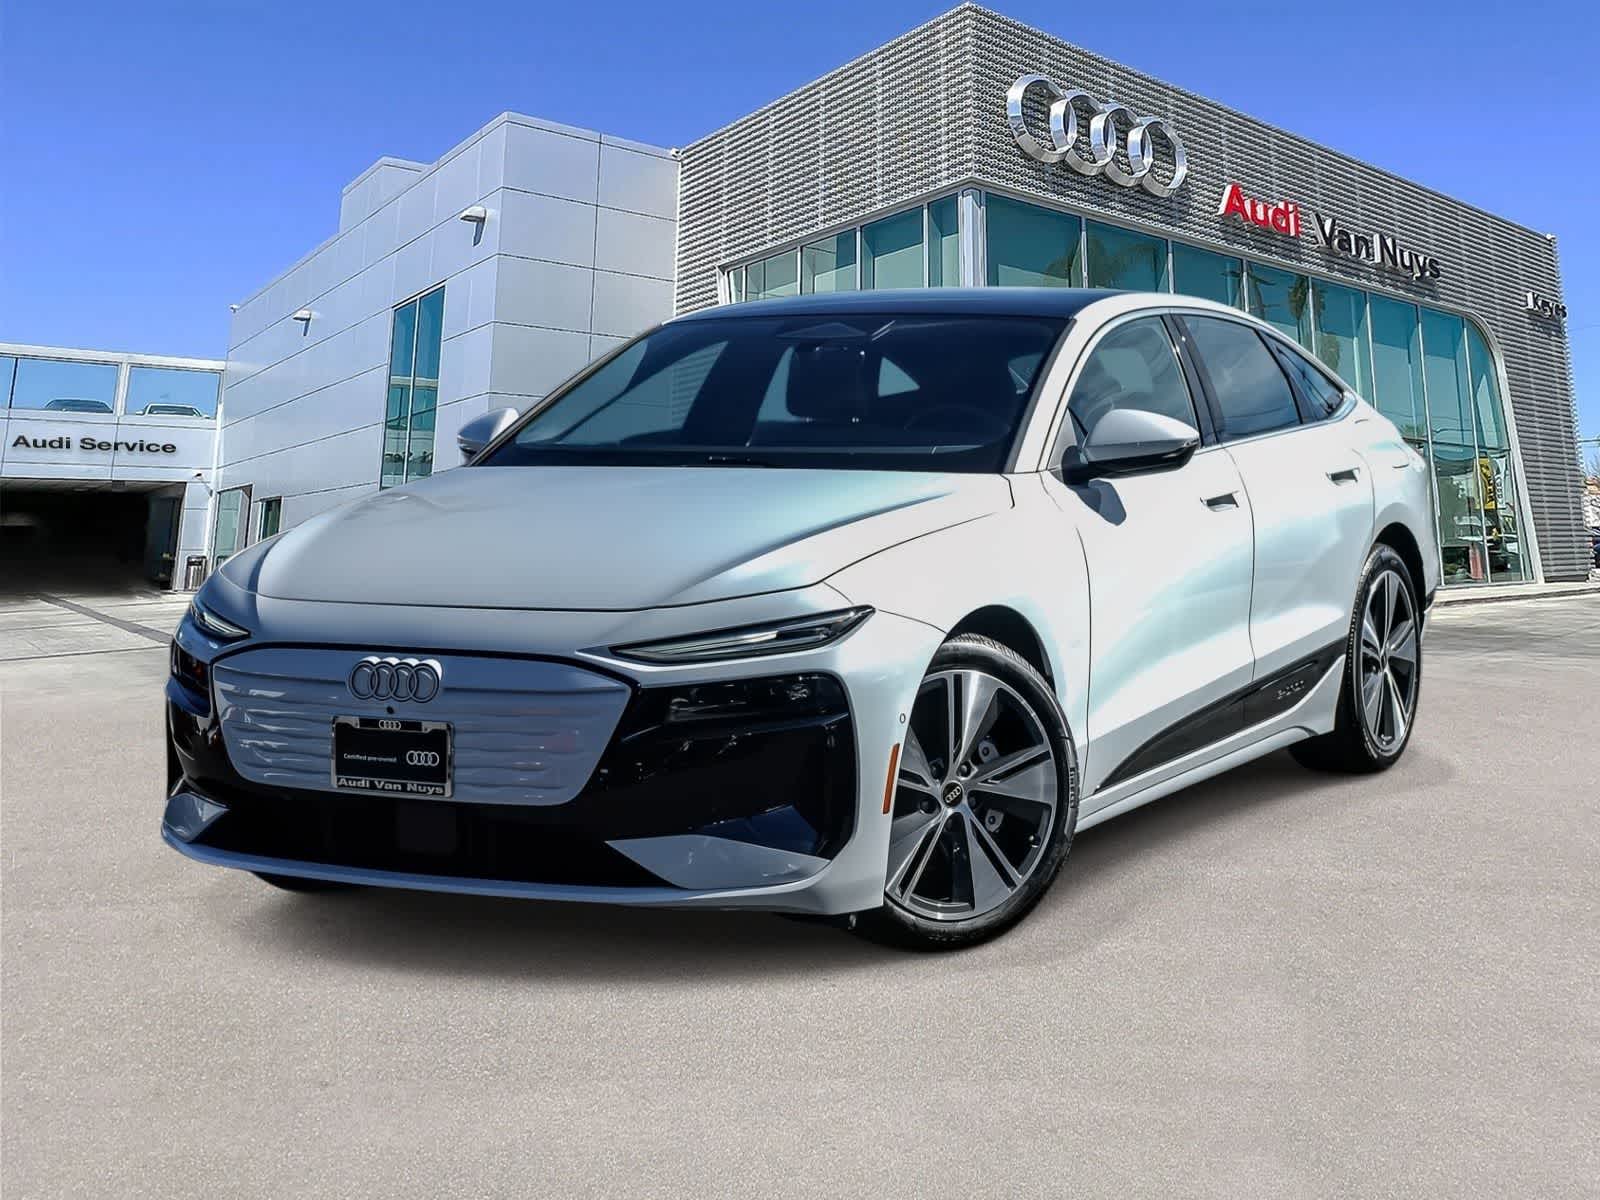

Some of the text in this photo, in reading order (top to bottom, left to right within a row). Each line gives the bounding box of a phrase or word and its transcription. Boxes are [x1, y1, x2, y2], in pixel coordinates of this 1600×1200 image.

[1218, 183, 1442, 280] Audi Van Nuys
[12, 435, 177, 453] Audi Service
[338, 777, 444, 794] Audi Van Nuys
